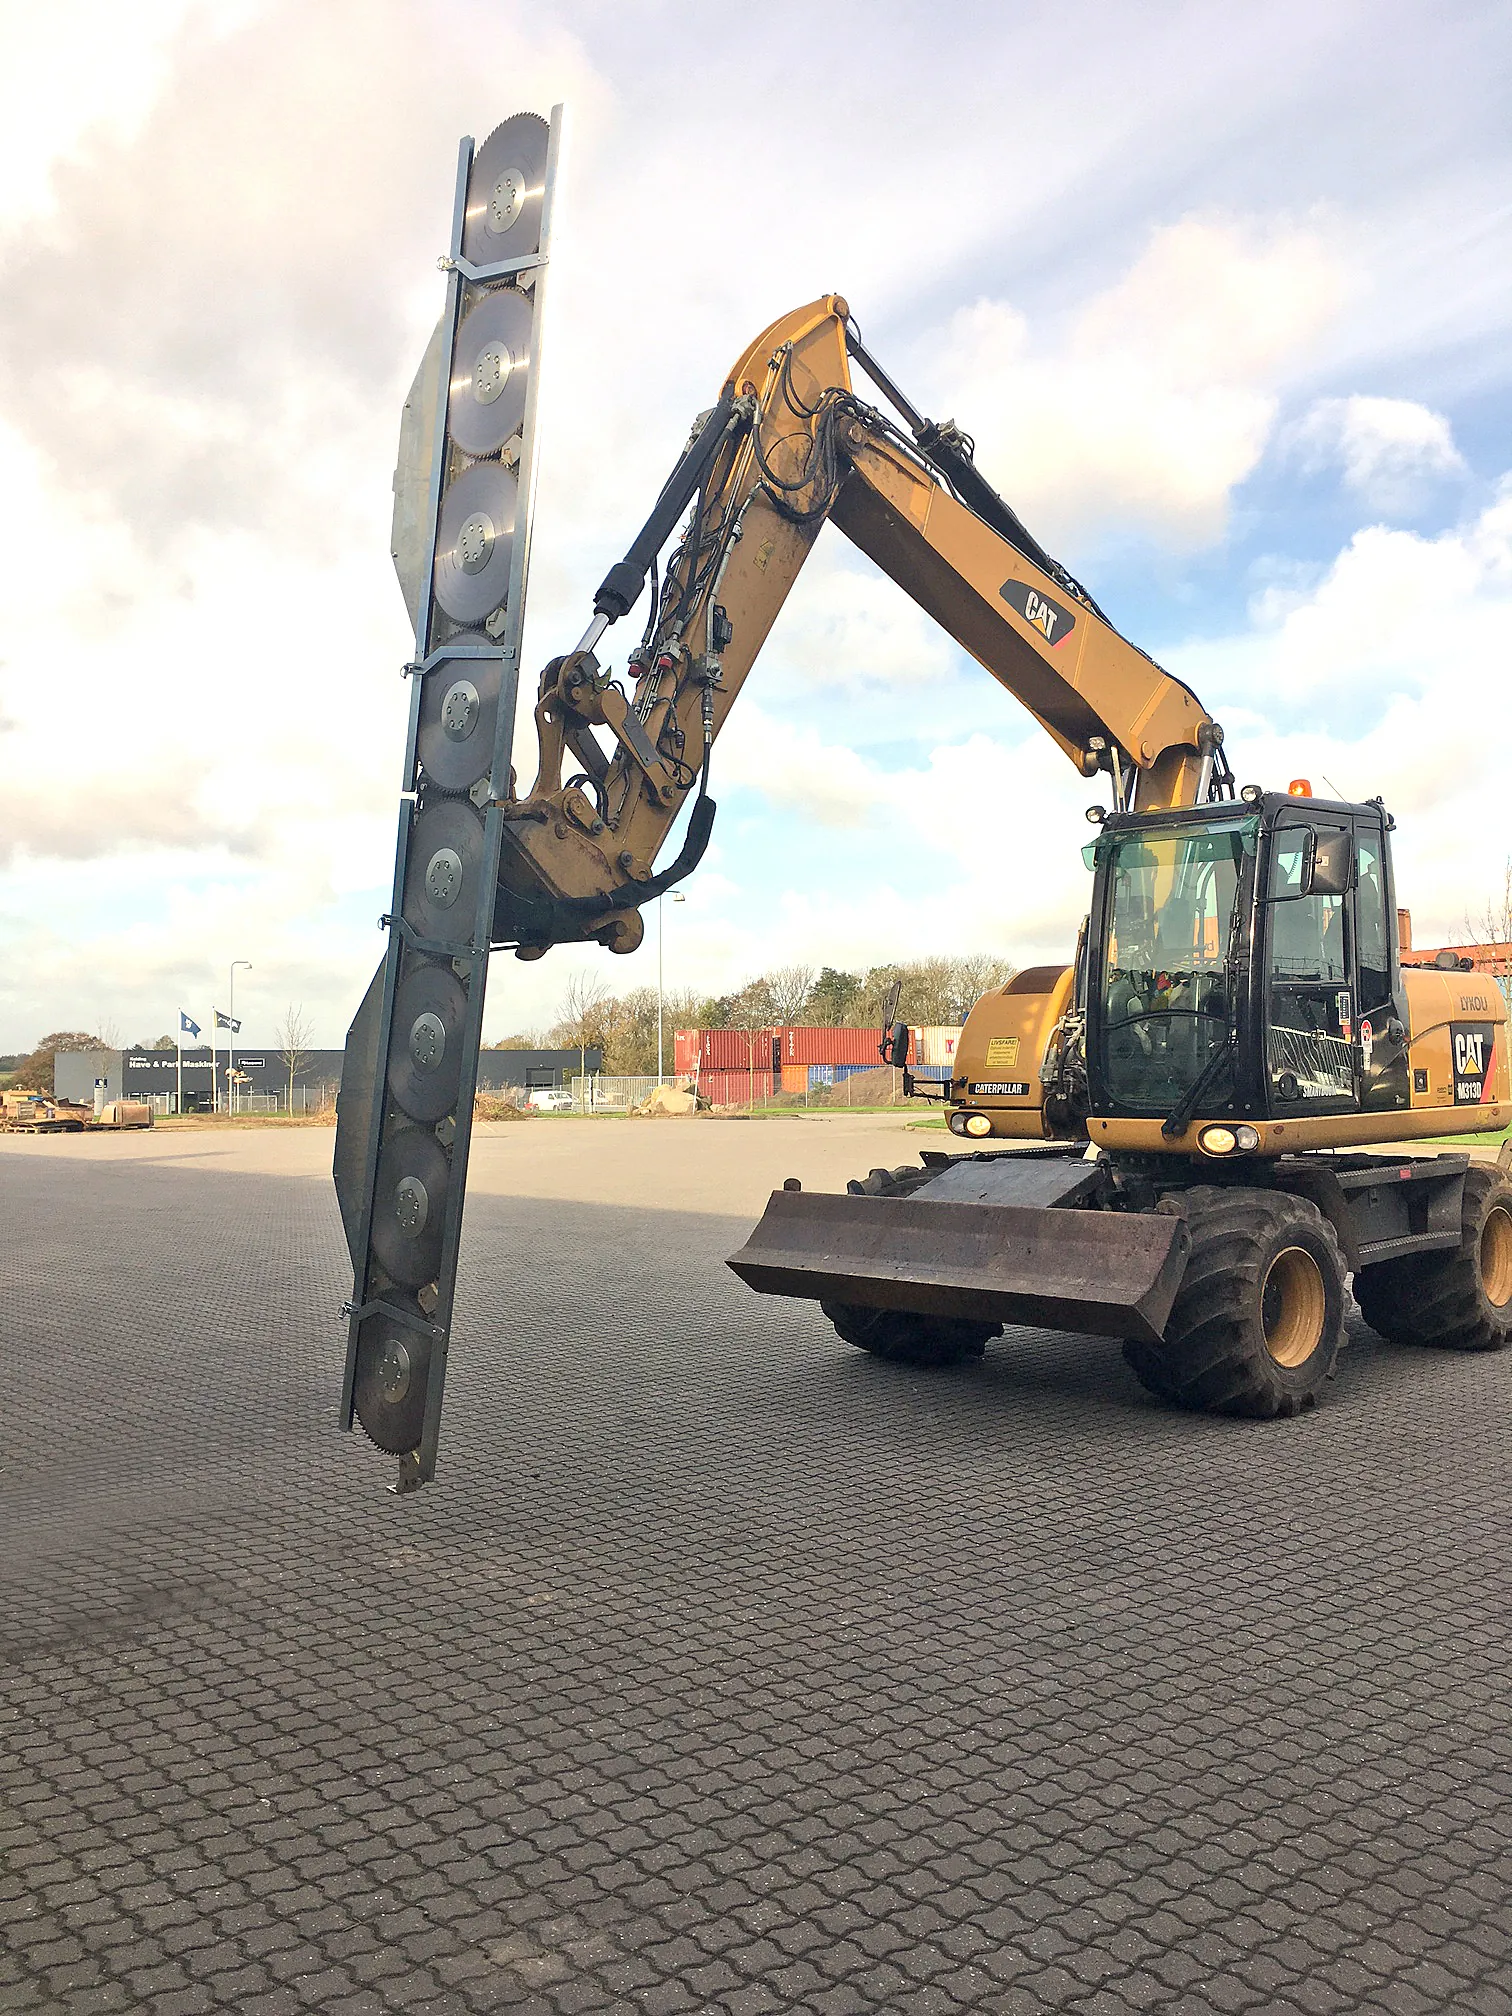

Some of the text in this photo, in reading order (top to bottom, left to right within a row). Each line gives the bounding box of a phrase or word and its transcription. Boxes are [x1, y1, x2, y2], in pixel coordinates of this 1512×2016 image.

[1025, 591, 1058, 640] CAT
[1454, 1033, 1484, 1075] CAT
[129, 1060, 151, 1068] Have
[153, 1060, 160, 1068] &
[974, 1083, 1023, 1095] CATERPILLAR
[1456, 1081, 1482, 1100] M313D
